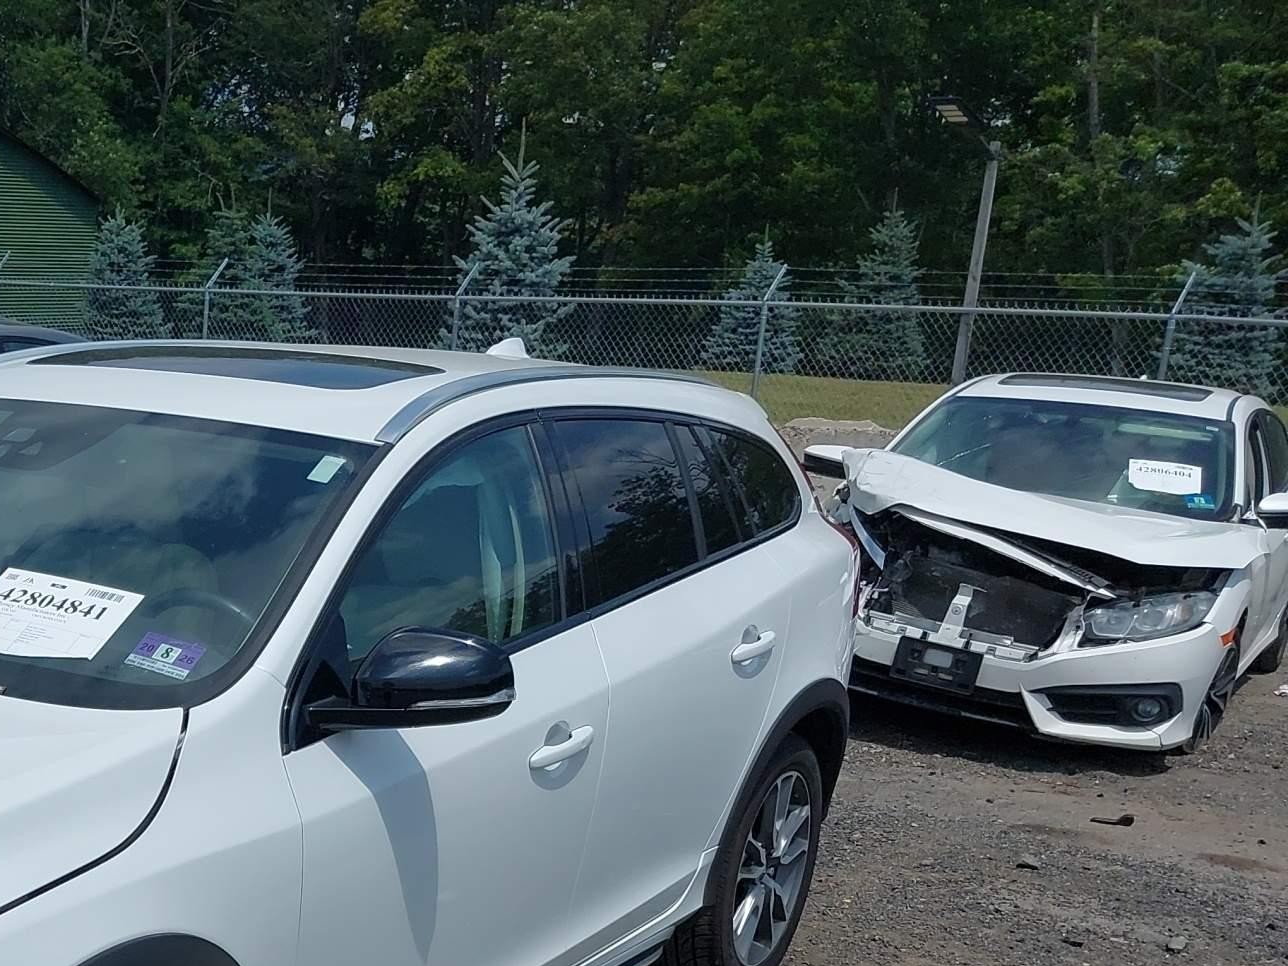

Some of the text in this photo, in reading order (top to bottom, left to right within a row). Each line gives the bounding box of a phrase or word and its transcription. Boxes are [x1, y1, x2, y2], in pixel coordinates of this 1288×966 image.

[1136, 466, 1192, 478] 42806404
[139, 642, 194, 665] 20 8 26
